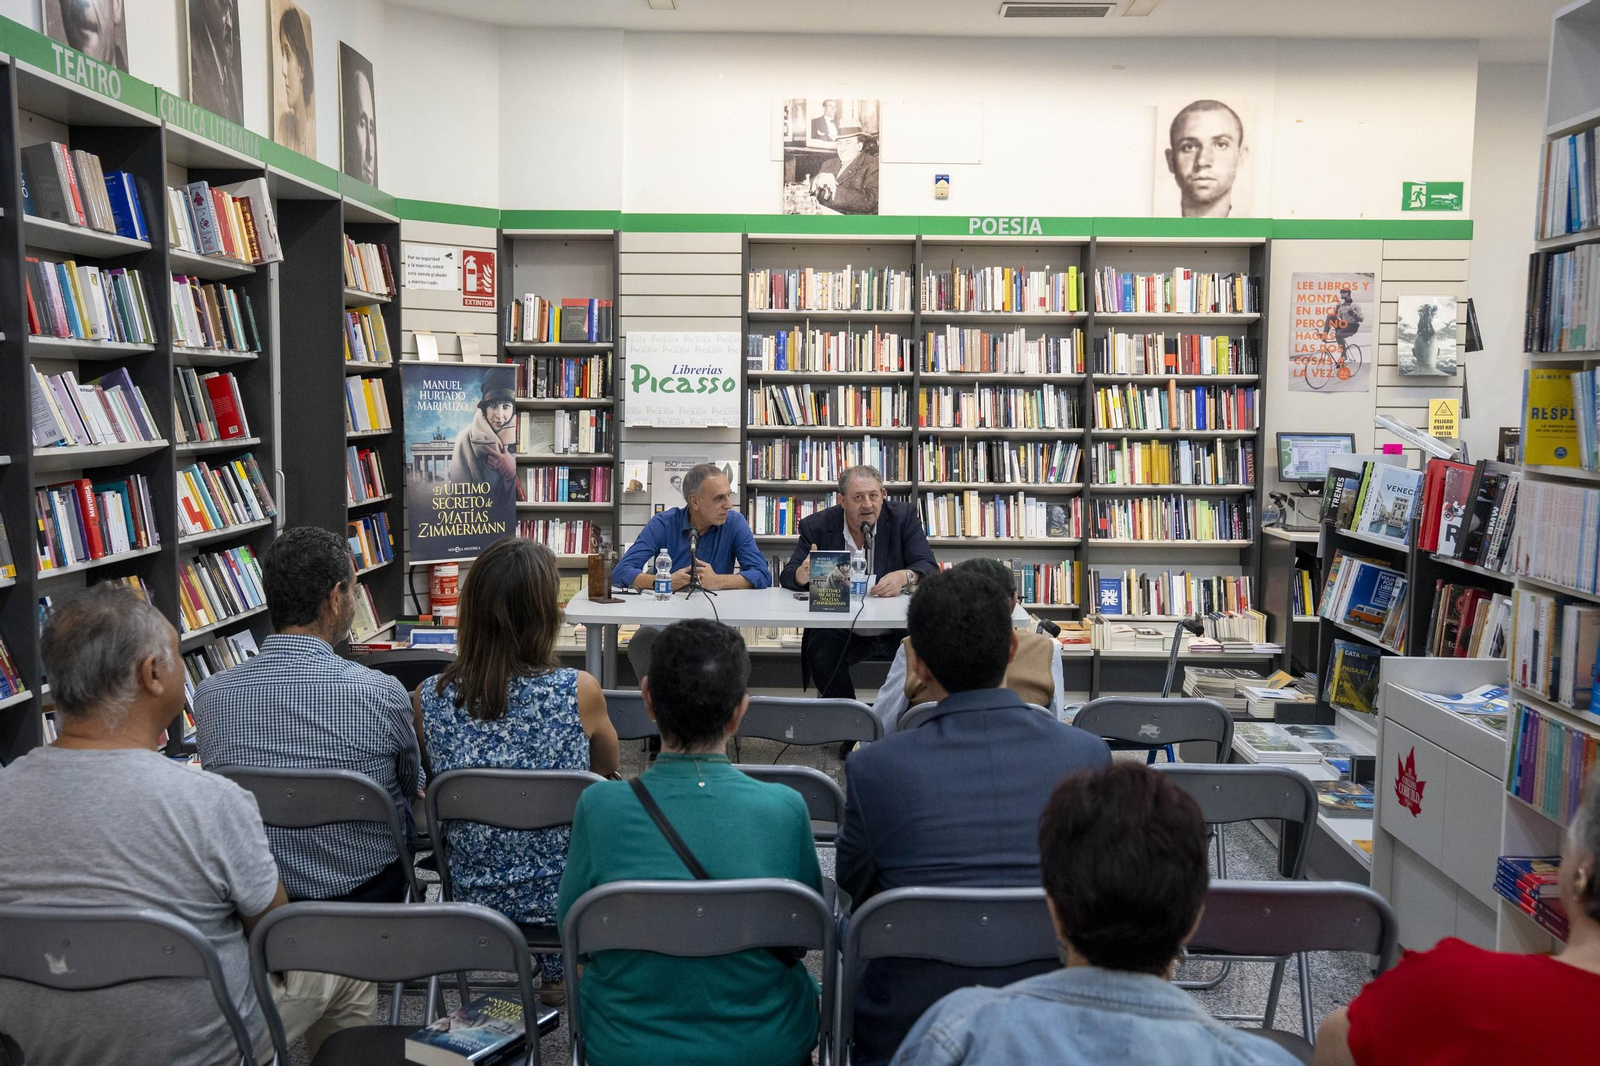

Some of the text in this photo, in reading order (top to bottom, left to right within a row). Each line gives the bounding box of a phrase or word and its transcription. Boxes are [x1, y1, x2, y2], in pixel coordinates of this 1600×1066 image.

[51, 42, 121, 100] TEATRO
[160, 93, 260, 160] CRITICA LITERARIA
[1296, 281, 1370, 291] LEE LIBROS Y
[464, 298, 493, 307] EXTINTOR
[1296, 294, 1340, 303] MONTA
[1296, 306, 1311, 316] EN
[1295, 319, 1349, 329] PERO NO
[1295, 332, 1336, 341] HAGAS
[1294, 344, 1344, 354] LAS DOS
[1293, 356, 1345, 366] COSAS A
[671, 364, 724, 375] Librerías
[1292, 369, 1308, 378] LA
[1311, 369, 1334, 378] VEZ
[630, 363, 736, 395] Picasso
[422, 380, 462, 390] MANUEL
[419, 390, 466, 400] HURTADO
[417, 401, 469, 412] MARJALIZO
[1531, 406, 1576, 421] RESPI
[432, 480, 491, 496] El ÚLTIMO
[1330, 476, 1345, 508] TRENES
[1386, 484, 1415, 496] VENEC
[84, 485, 96, 518] MAYORGA
[432, 496, 493, 510] SECRETO de
[437, 508, 489, 526] MATÍAS
[1486, 506, 1500, 535] BMW
[417, 522, 506, 538] ZIMMERMANN
[1344, 650, 1360, 658] CATA
[1342, 666, 1369, 676] PAISAJES
